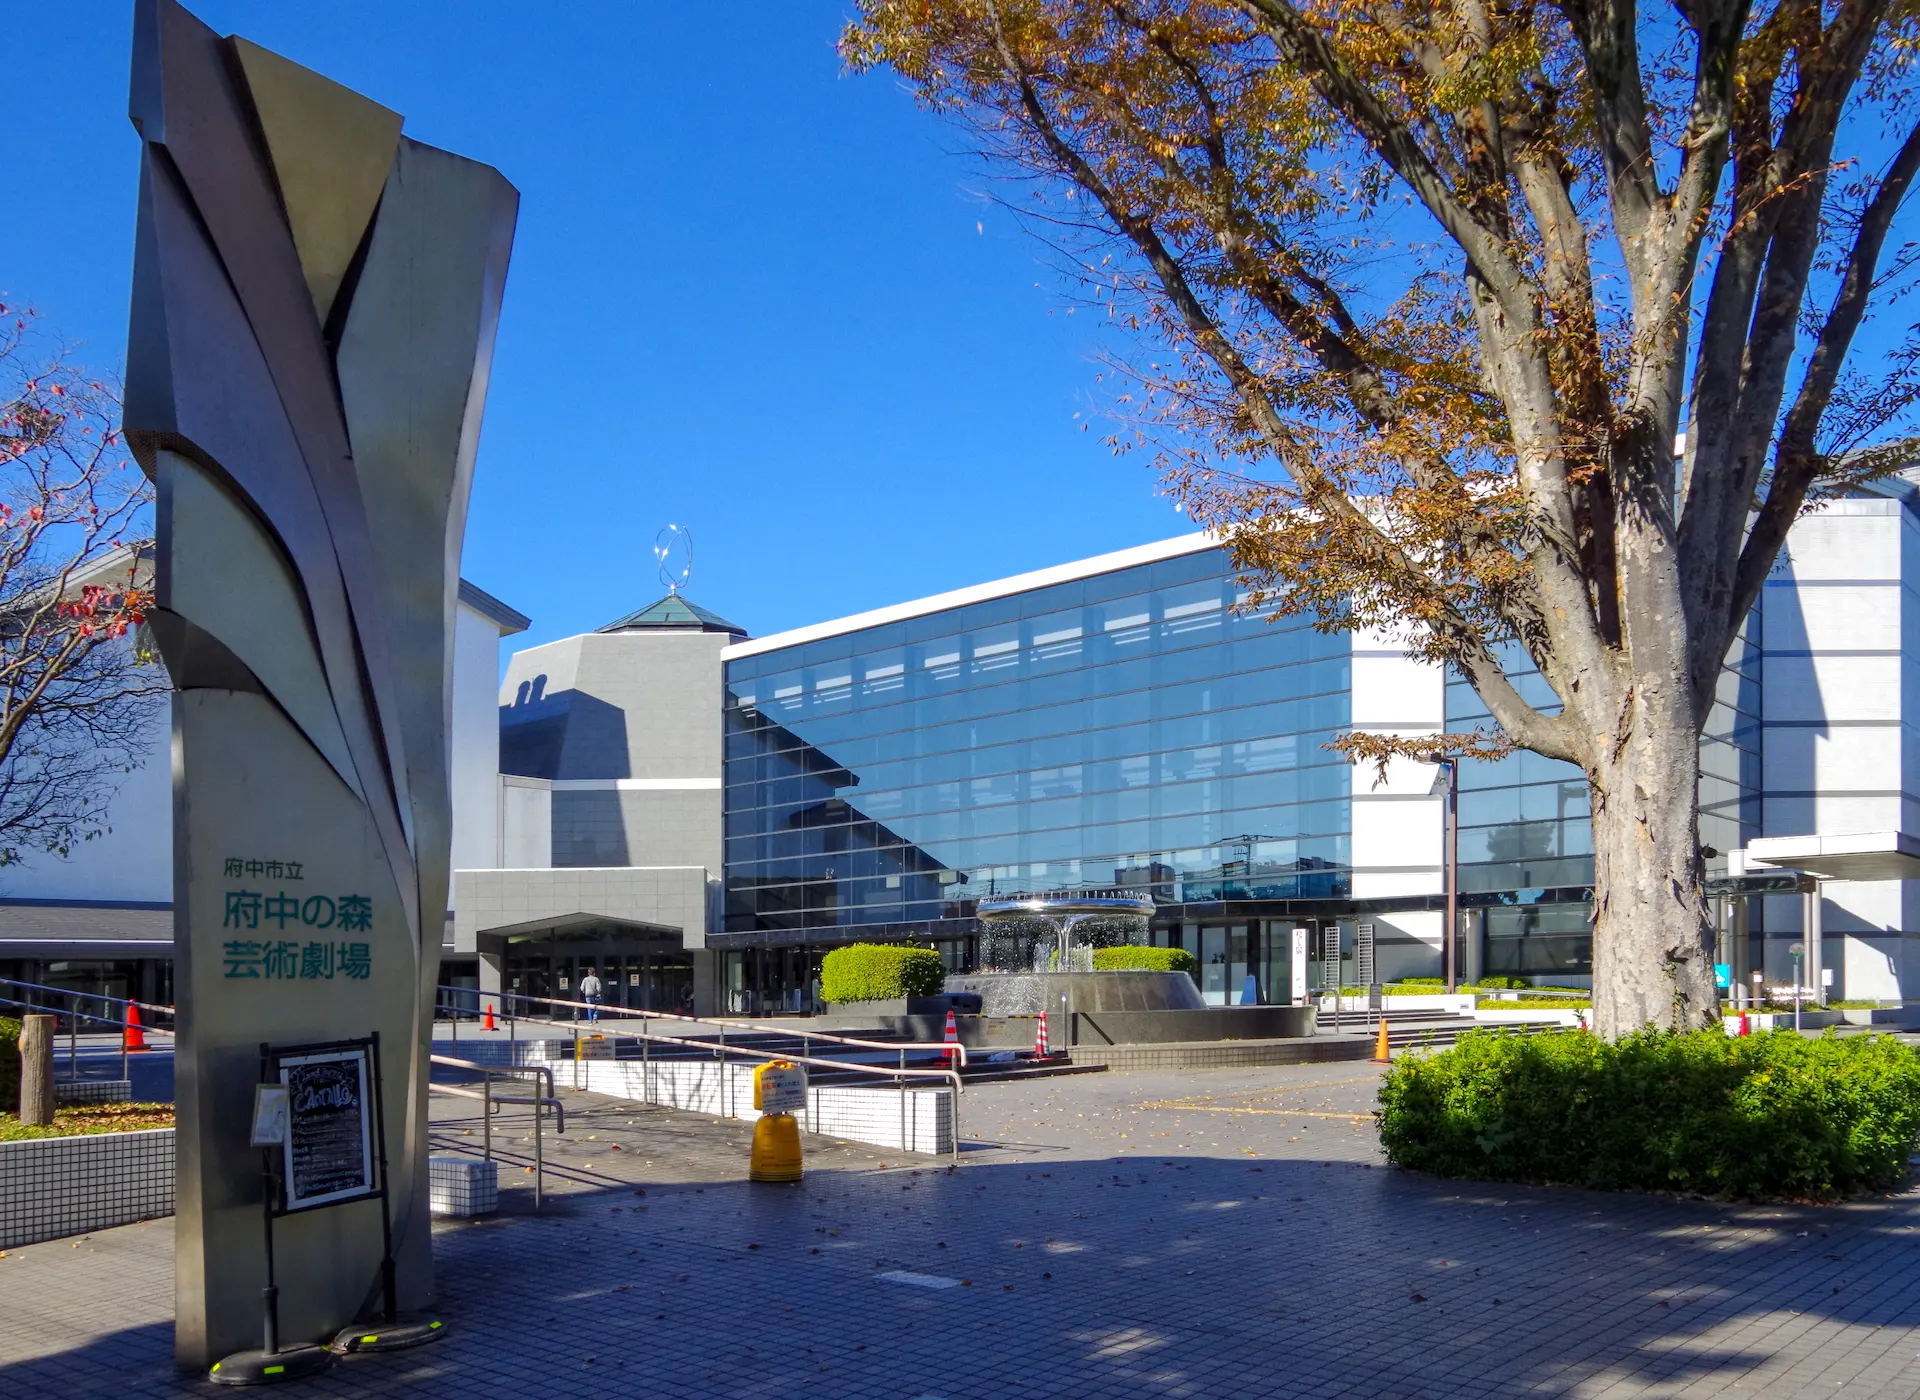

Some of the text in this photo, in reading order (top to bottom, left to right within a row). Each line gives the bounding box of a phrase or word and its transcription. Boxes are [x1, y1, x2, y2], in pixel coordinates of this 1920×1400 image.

[223, 857, 304, 881] 府中市立
[223, 889, 373, 933] 府中の森
[223, 940, 372, 980] 芸術劇場
